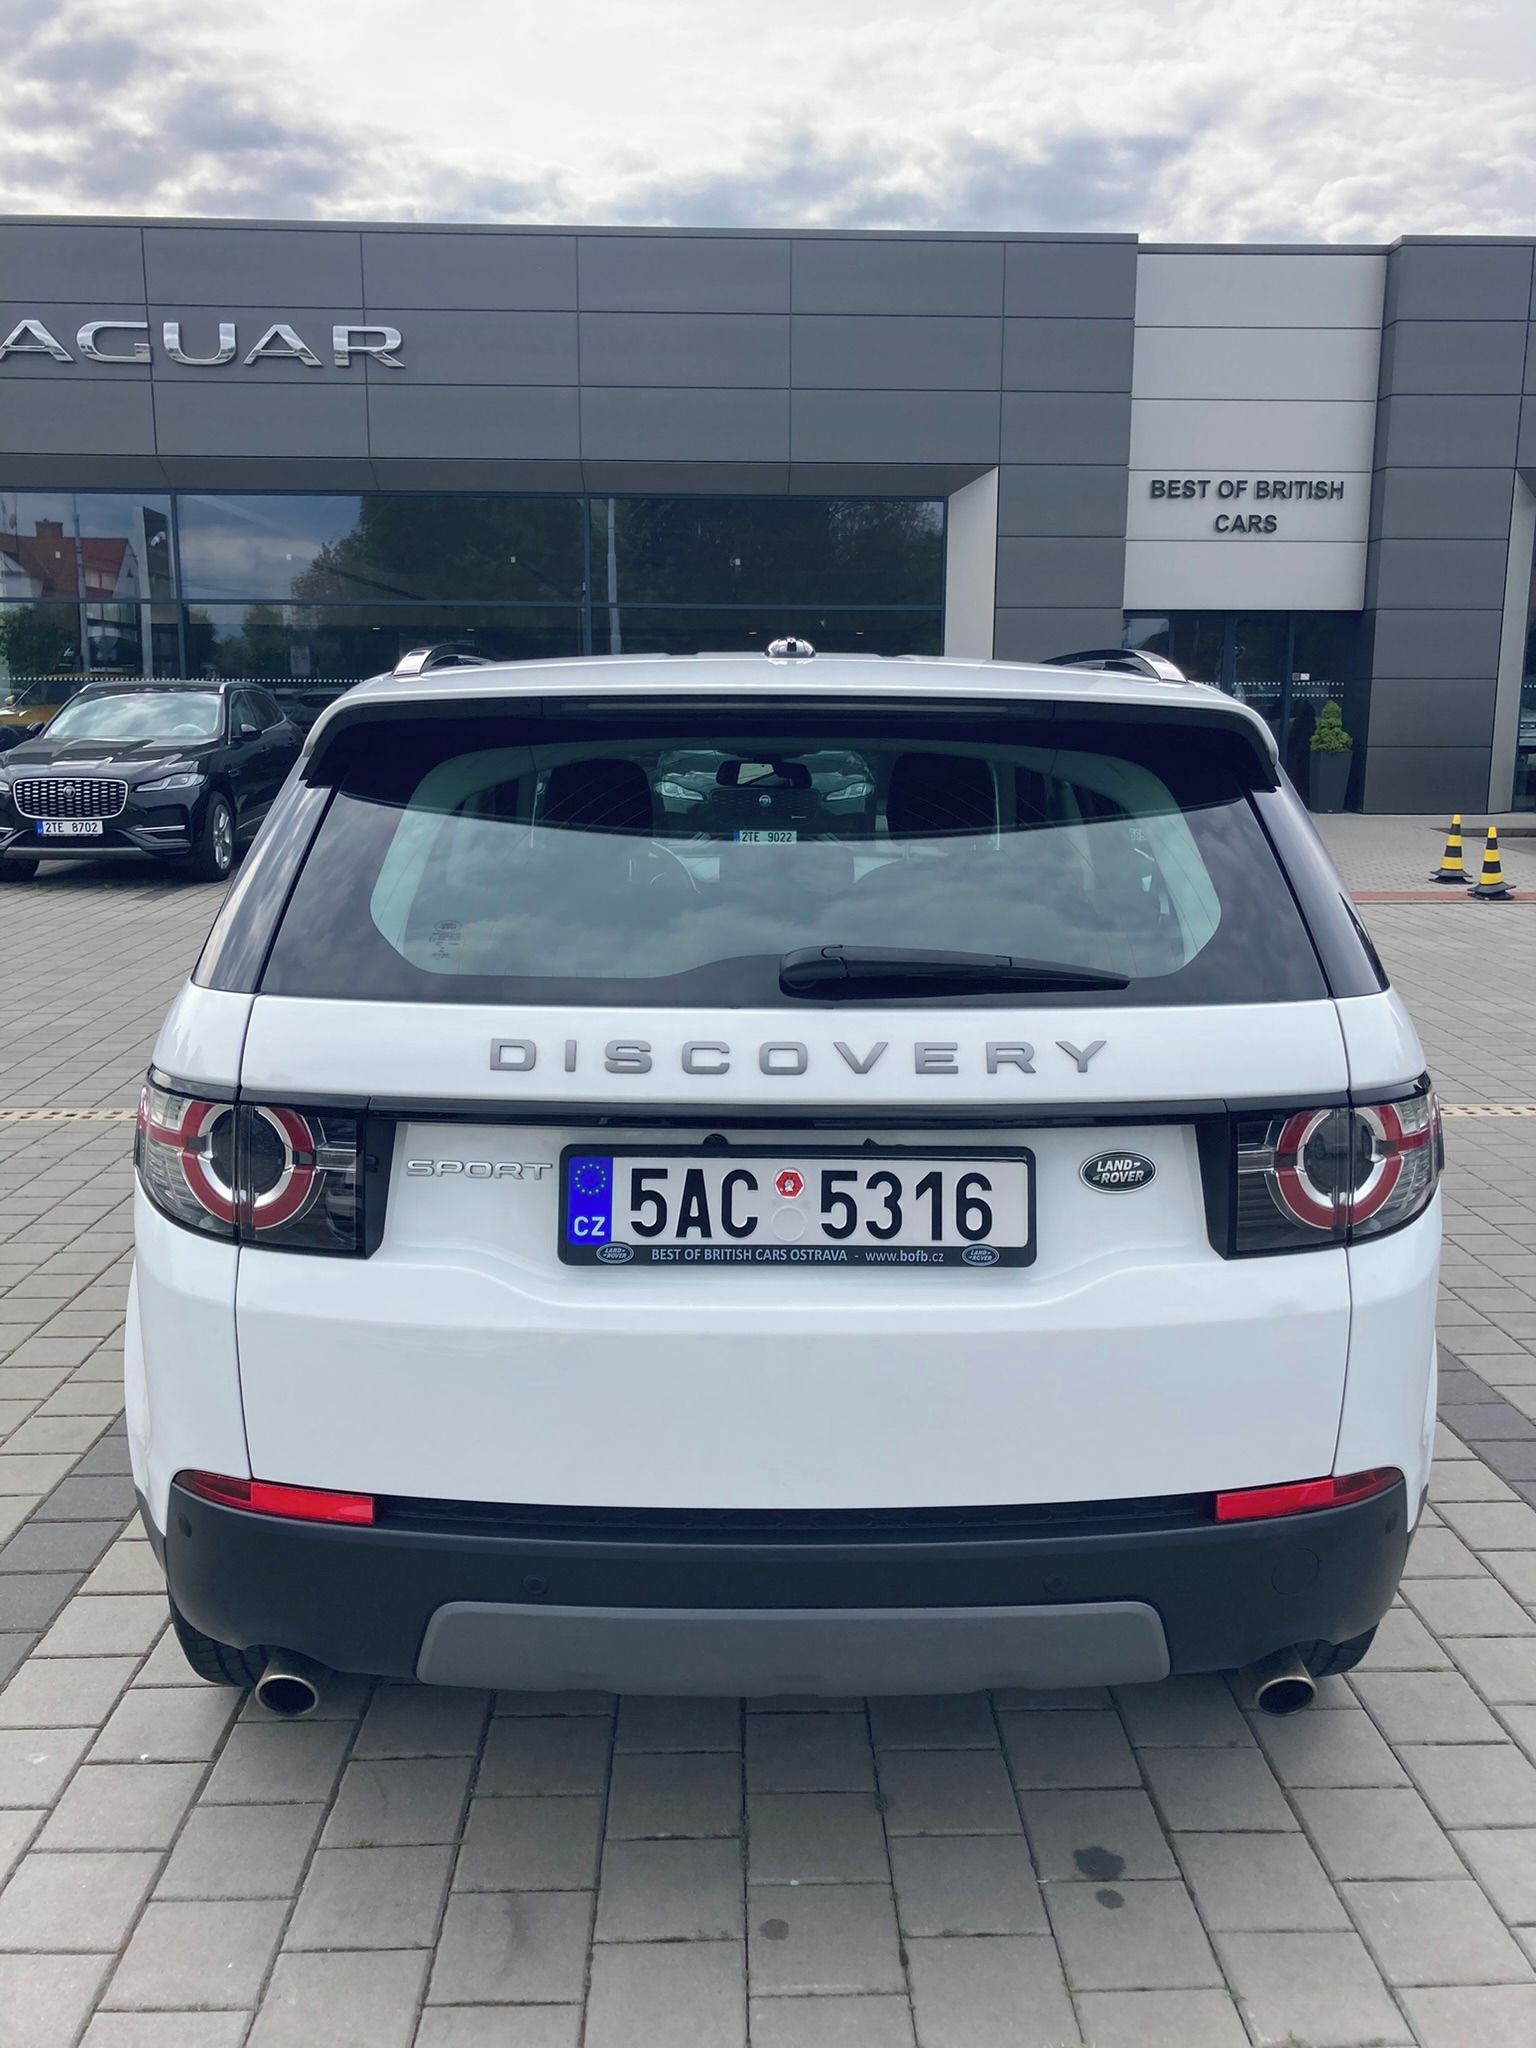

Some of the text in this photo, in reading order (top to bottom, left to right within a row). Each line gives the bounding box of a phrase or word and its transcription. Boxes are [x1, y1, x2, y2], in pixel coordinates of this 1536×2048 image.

[1150, 480, 1345, 500] BEST OF BRITISH
[1214, 514, 1278, 533] CARS
[45, 822, 98, 833] 2TE 8702
[741, 831, 792, 843] 2TE 9022
[489, 1038, 1107, 1076] DISCOVERY
[406, 1158, 553, 1181] SPORT
[1096, 1159, 1133, 1173] LAND
[1100, 1170, 1144, 1184] ROVER
[630, 1167, 993, 1242] 5AC 5316
[573, 1215, 606, 1237] CZ
[651, 1248, 681, 1261] BEST
[684, 1248, 701, 1261] OF
[704, 1248, 752, 1261] BRITISH
[755, 1248, 787, 1261] CARS
[790, 1249, 848, 1261] OSTRAVA
[865, 1250, 944, 1263] www.bofb.cz
